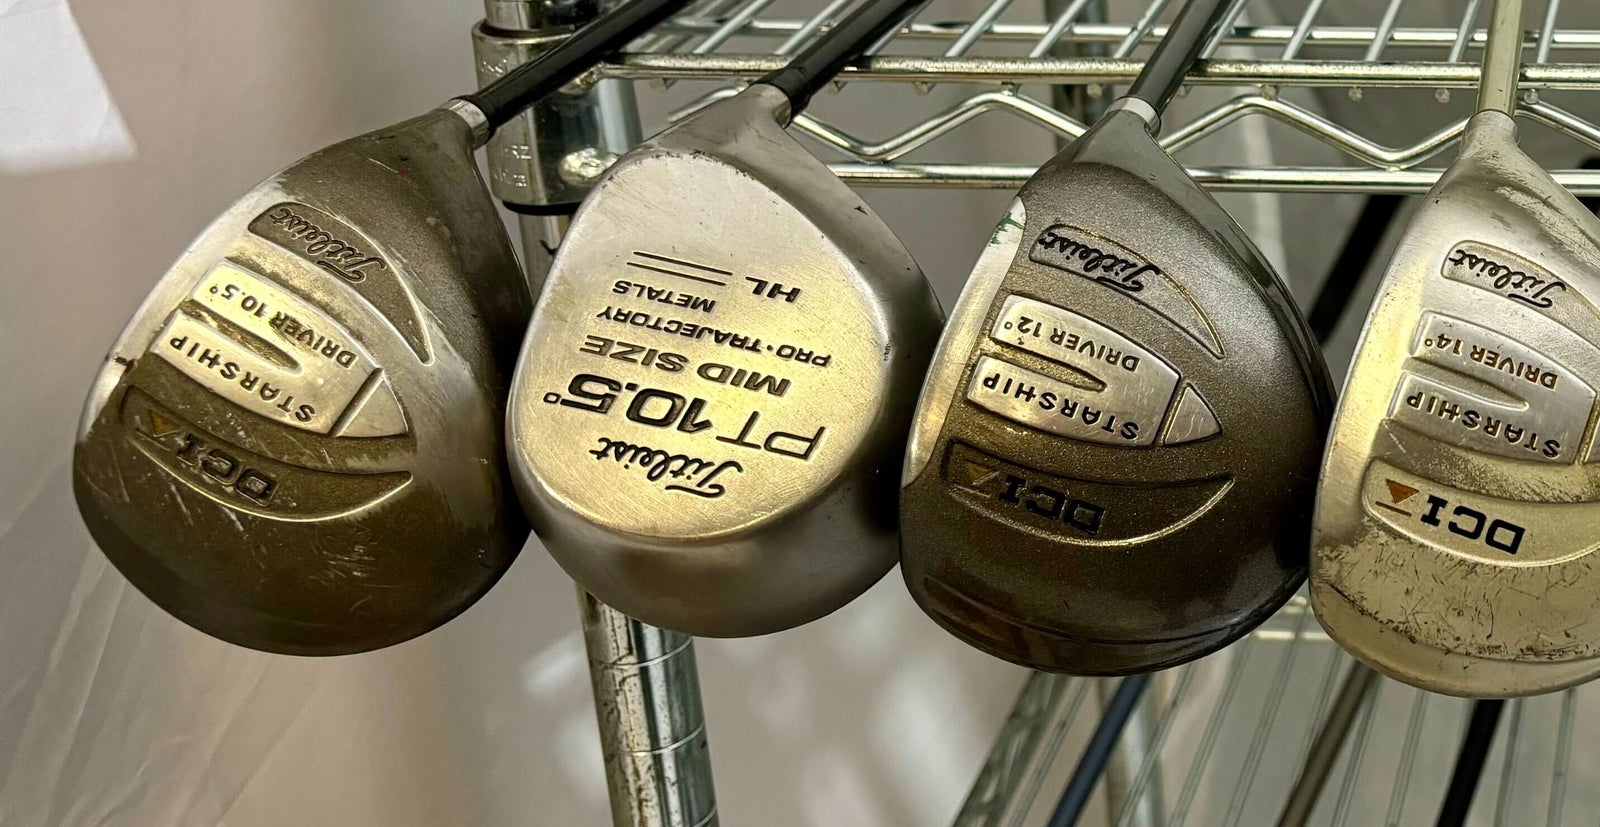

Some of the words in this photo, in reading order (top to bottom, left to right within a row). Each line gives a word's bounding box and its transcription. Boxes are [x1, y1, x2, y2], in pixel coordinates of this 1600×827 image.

[269, 208, 387, 283] Titleist
[1038, 232, 1161, 292] Titleist
[612, 280, 715, 313] METALS
[745, 276, 801, 303] HL
[1449, 249, 1566, 308] Titleist
[267, 310, 357, 369] DRIVER
[579, 335, 690, 372] SIZE
[1004, 315, 1042, 338] 12°
[1049, 327, 1140, 372] DRIVER
[169, 334, 316, 423] STARSHIP
[697, 362, 792, 397] MID
[1470, 345, 1557, 389] DRIVER
[543, 372, 714, 434] 10.5°
[983, 374, 1140, 440] STARSHIP
[1406, 391, 1561, 458] STARSHIP
[715, 410, 825, 460] PT
[176, 432, 280, 505] DCI
[589, 437, 743, 498] Titleist
[999, 475, 1106, 534] DCI
[1420, 494, 1526, 555] DCI
